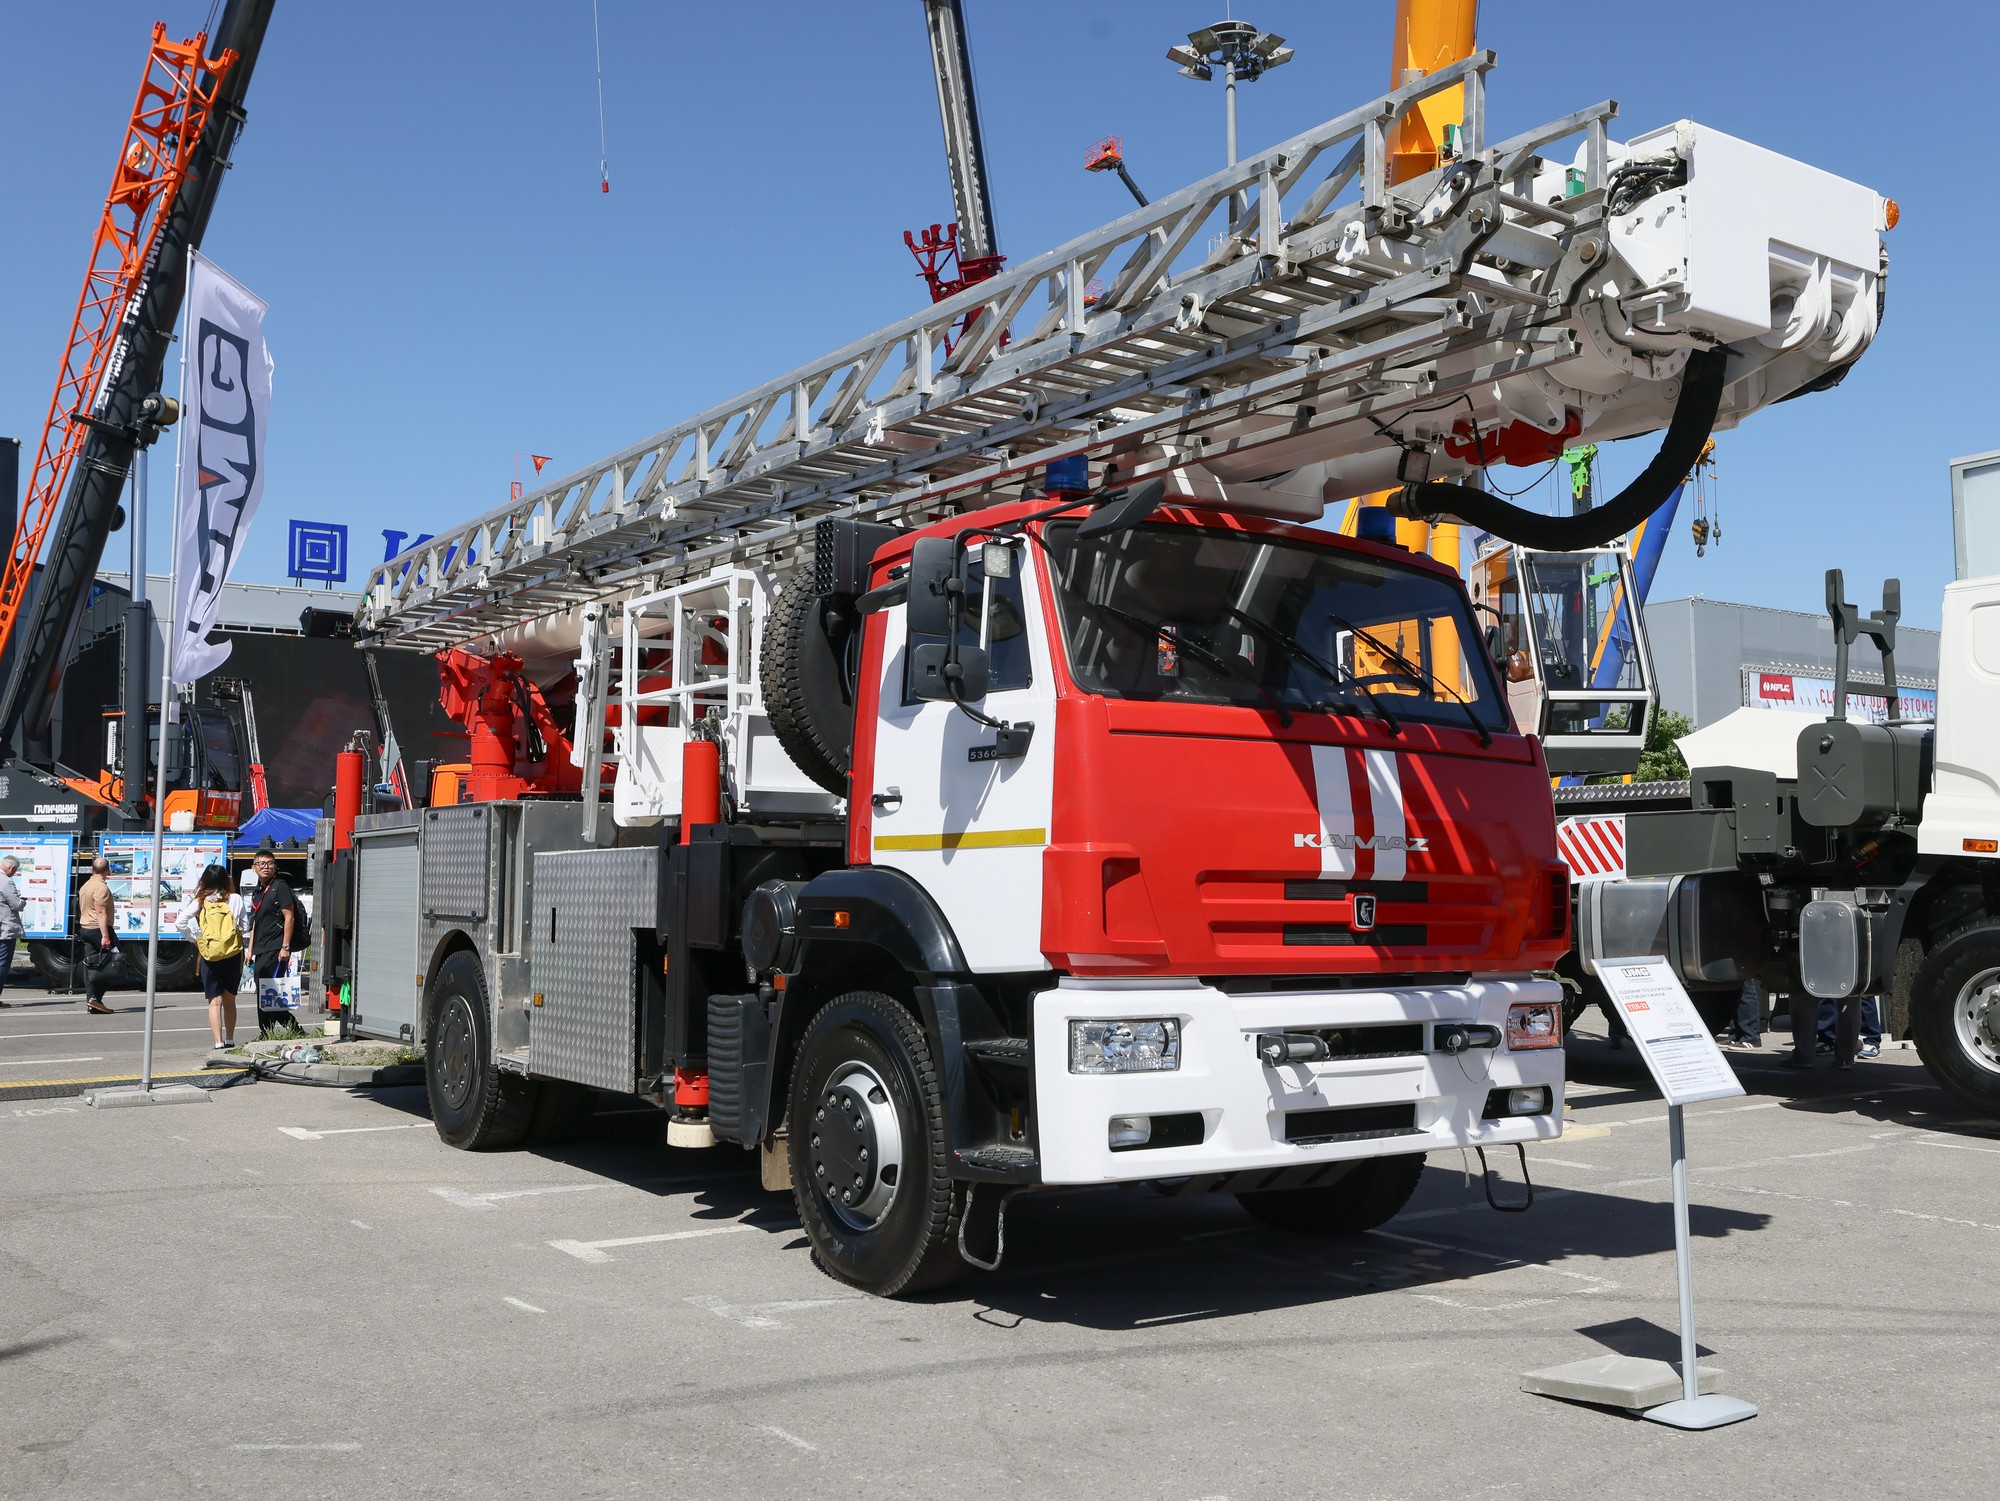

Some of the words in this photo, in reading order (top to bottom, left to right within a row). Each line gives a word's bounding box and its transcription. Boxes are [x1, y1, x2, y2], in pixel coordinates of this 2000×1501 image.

[1820, 688, 1851, 706] CLOE
[33, 803, 78, 814] ГАЛИЧАНИН
[1293, 833, 1429, 852] KAMAZ
[1621, 967, 1650, 978] UMG
